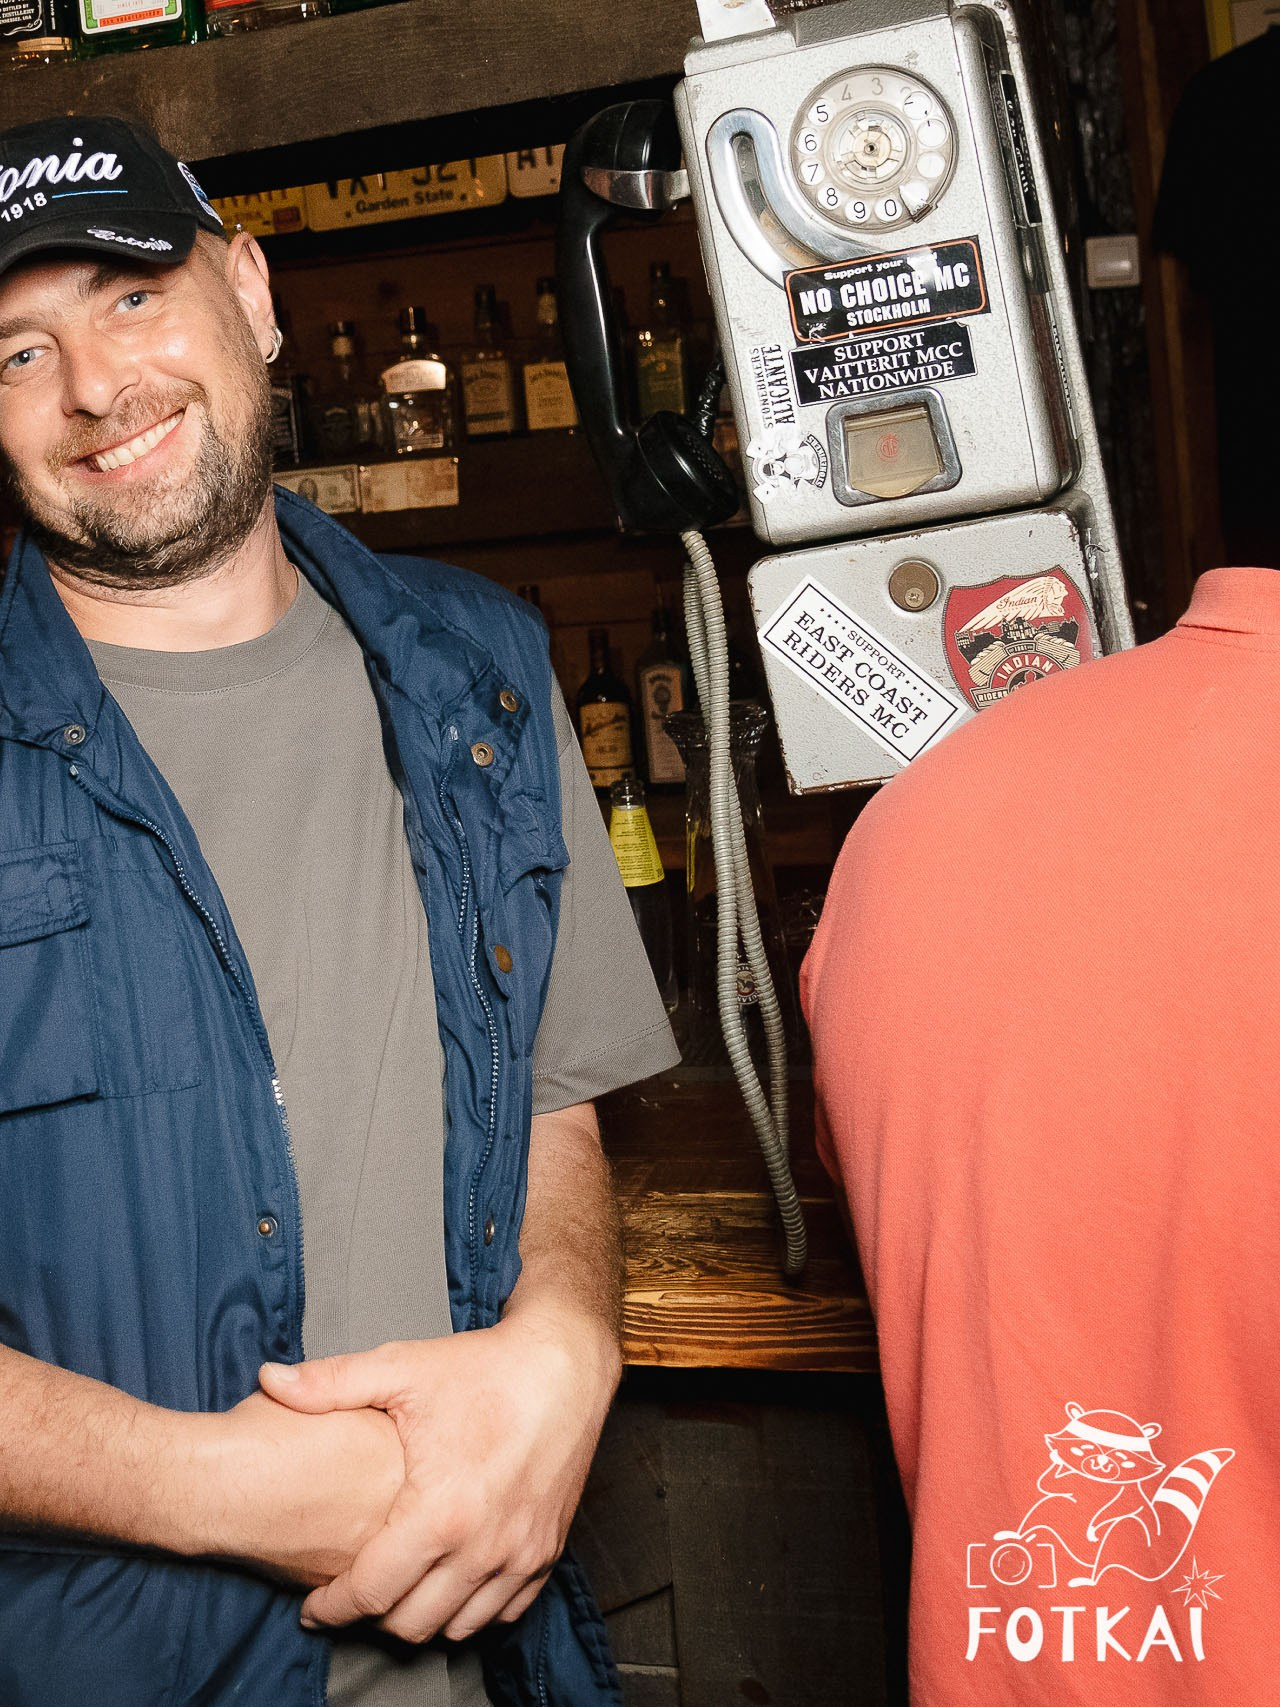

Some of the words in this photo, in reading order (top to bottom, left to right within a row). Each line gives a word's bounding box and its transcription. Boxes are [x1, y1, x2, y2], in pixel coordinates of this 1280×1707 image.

[842, 84, 853, 102] 4
[872, 77, 884, 96] 3
[816, 104, 829, 123] 5
[804, 134, 818, 152] 6
[807, 163, 819, 182] 7
[1, 192, 48, 224] 1918
[356, 194, 409, 214] Garden
[414, 188, 454, 206] State
[826, 187, 838, 206] 8
[853, 201, 866, 219] 9
[884, 199, 897, 217] 0
[823, 264, 873, 281] Support
[876, 260, 904, 273] your
[799, 288, 832, 316] NO
[840, 271, 927, 309] CHOICE
[934, 262, 970, 292] MC
[847, 298, 931, 327] STOCKHOLM
[834, 332, 925, 362] SUPPORT
[804, 352, 912, 385] VAITTERIT
[915, 341, 964, 366] MCC
[750, 347, 775, 429] STONEBIKERS
[761, 343, 796, 425] ALICANTE
[818, 360, 956, 400] NATIONWIDE
[996, 597, 1039, 610] Indian
[794, 610, 854, 663] EAST
[854, 662, 928, 725] COAST
[847, 629, 906, 681] SUPPORT
[997, 655, 1054, 680] INDIAN
[783, 630, 870, 706] RIDERS
[870, 706, 910, 740] MC
